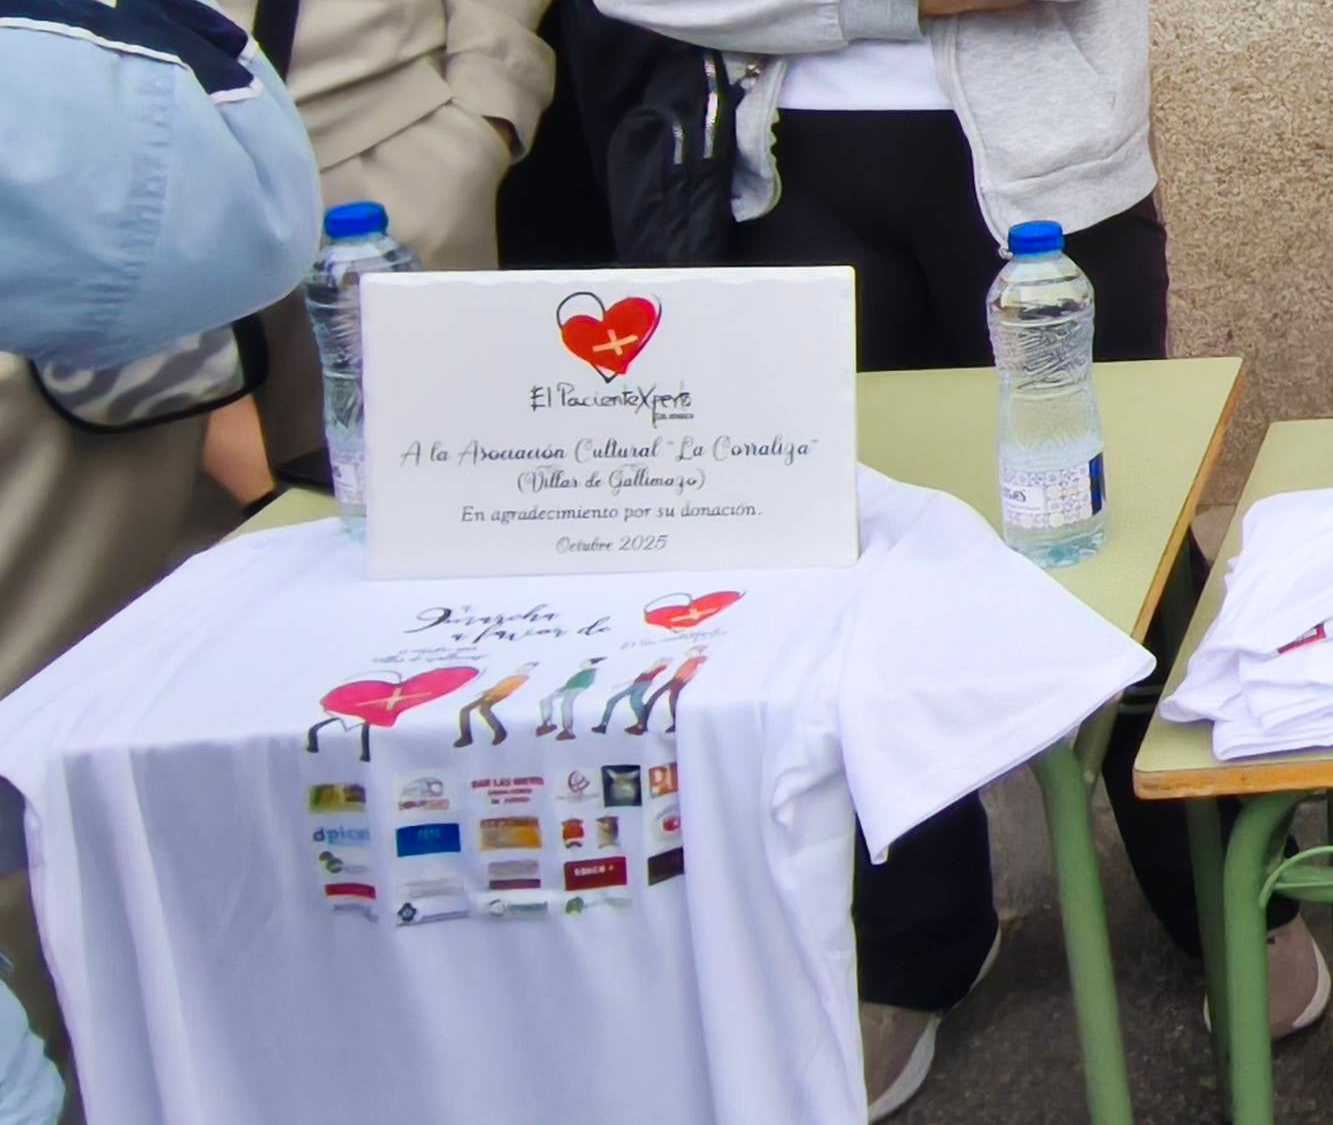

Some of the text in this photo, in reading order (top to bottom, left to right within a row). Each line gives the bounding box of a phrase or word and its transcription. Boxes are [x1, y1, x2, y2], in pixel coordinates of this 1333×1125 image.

[530, 385, 552, 412] El
[400, 440, 422, 467] A
[429, 441, 449, 463] la
[457, 439, 566, 467] Asociación
[574, 437, 663, 465] Cultural
[584, 472, 602, 489] de
[461, 500, 763, 525] En agradecimiento por su donación.
[556, 533, 669, 555] Octubre 2025
[577, 616, 612, 637] de
